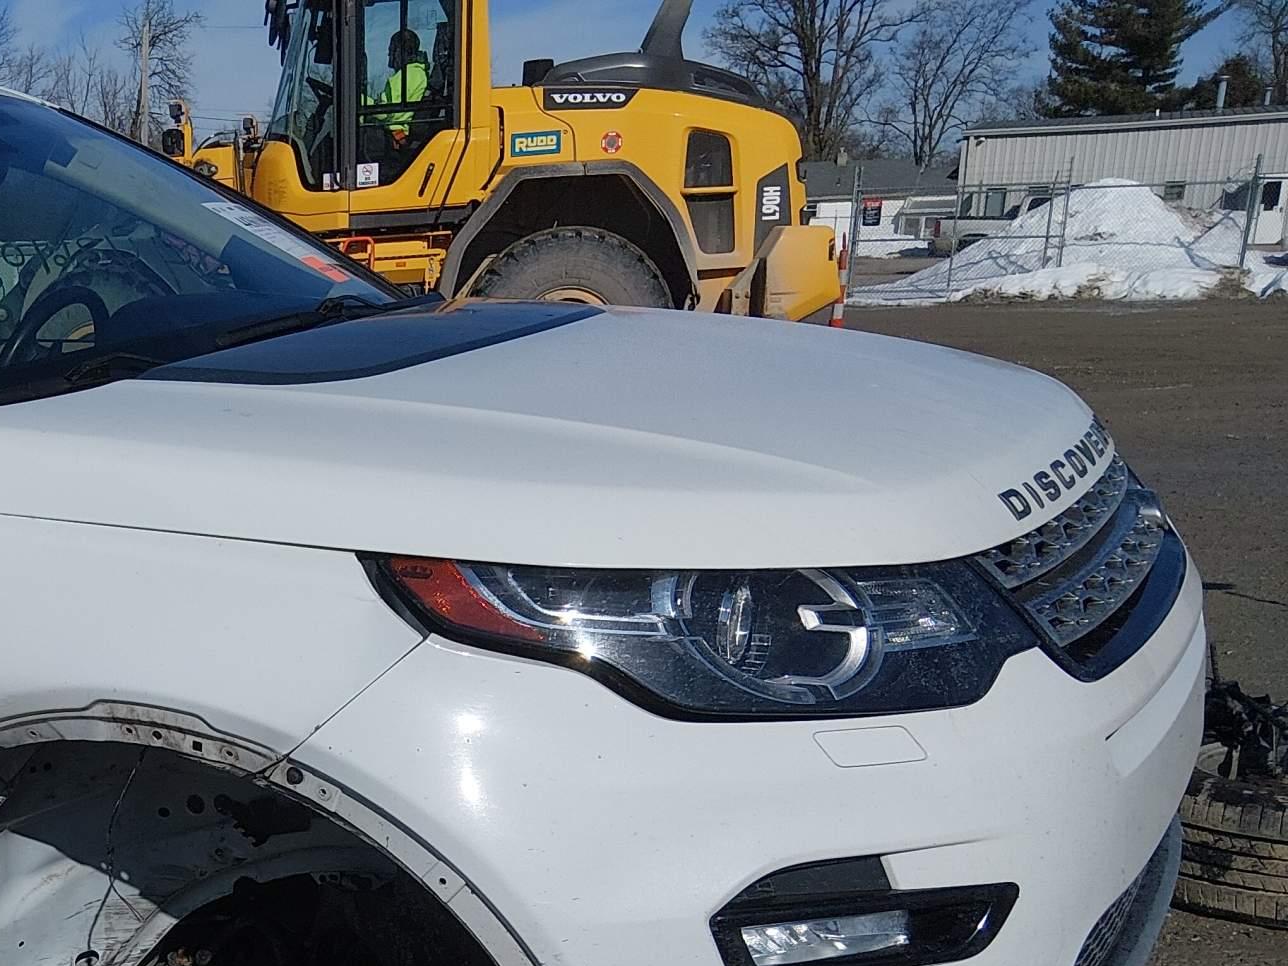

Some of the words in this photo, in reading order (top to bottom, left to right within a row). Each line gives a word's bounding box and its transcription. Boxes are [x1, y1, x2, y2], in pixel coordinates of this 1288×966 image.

[550, 92, 626, 104] VOLVO
[514, 134, 558, 153] RUDD
[761, 185, 782, 221] L90H
